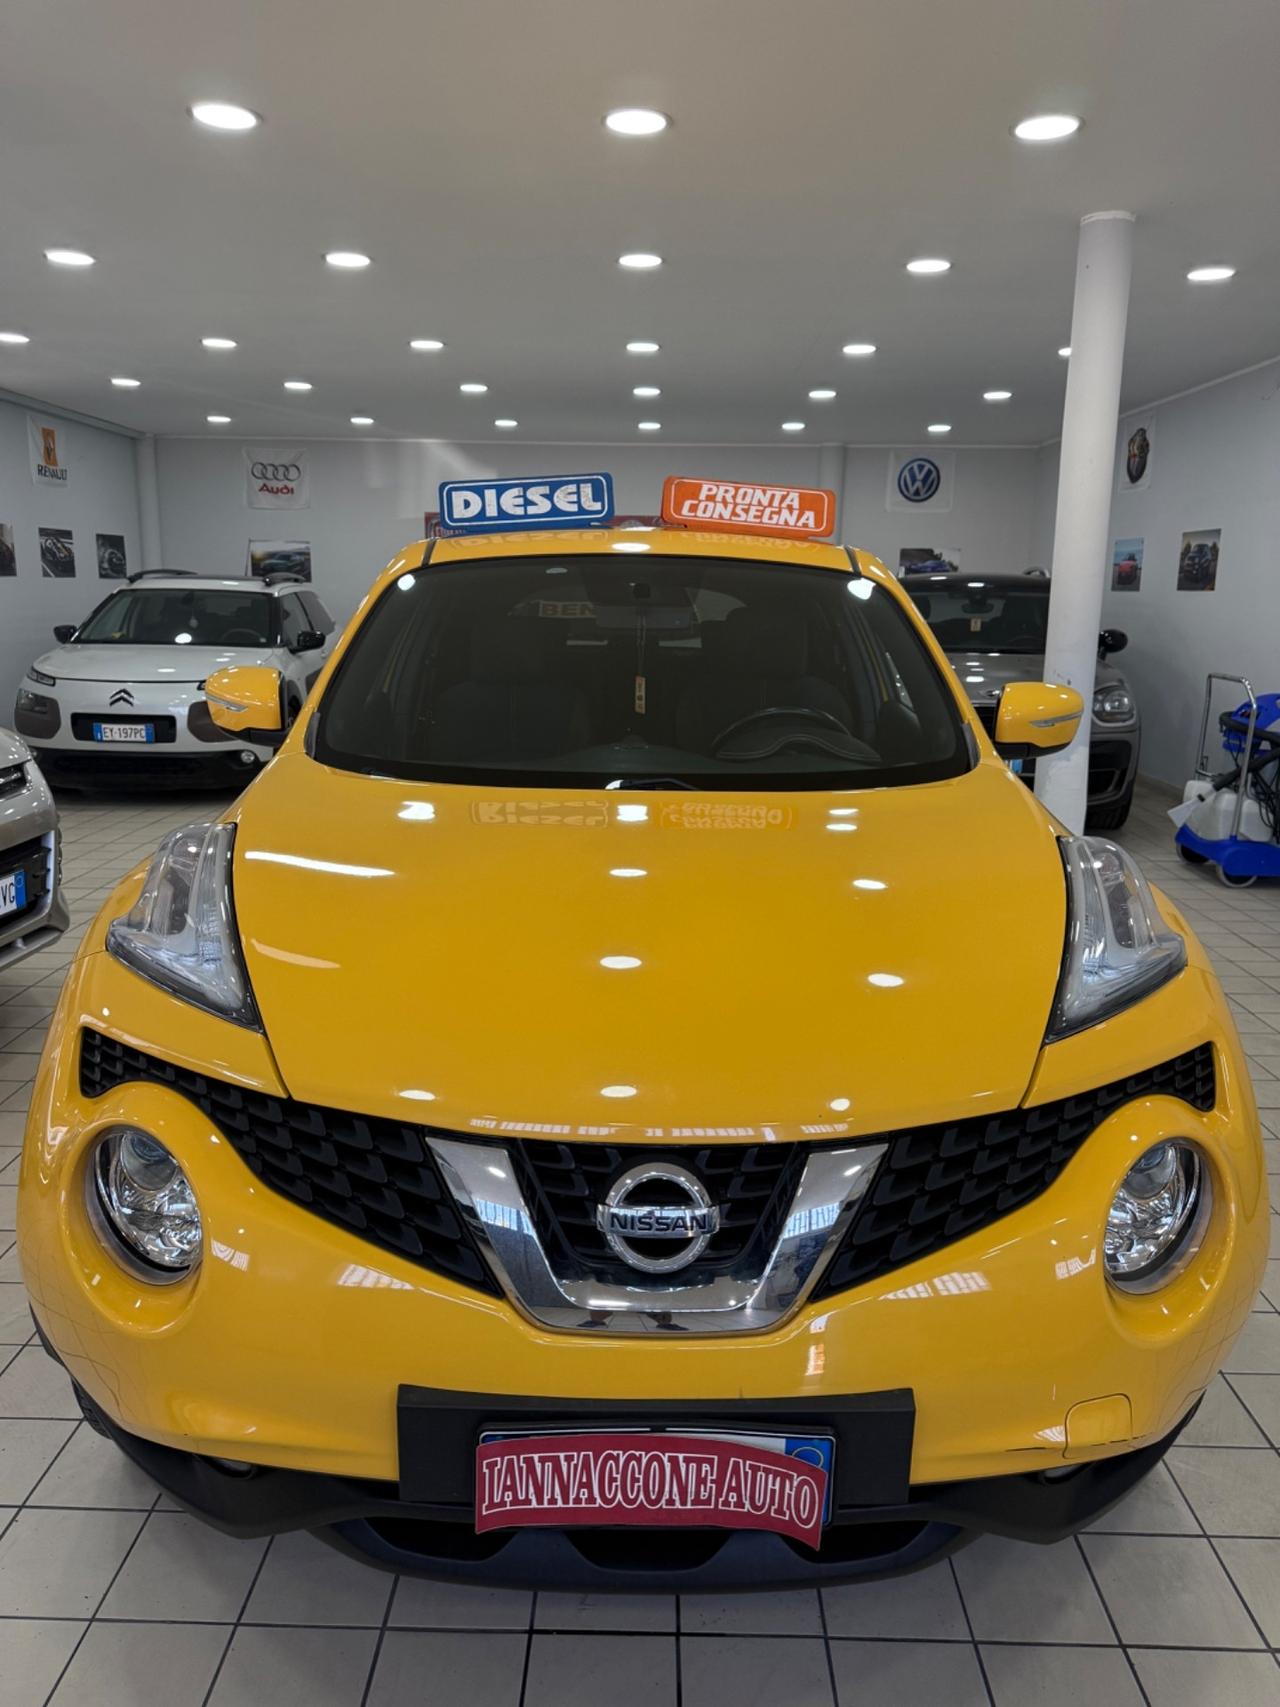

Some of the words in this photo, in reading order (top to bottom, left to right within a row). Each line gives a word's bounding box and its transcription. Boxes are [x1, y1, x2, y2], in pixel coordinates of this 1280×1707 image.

[259, 483, 294, 495] Audi
[452, 483, 602, 519] DIESEL
[699, 484, 800, 509] PRONTA
[681, 500, 815, 528] CONSEGNA
[0, 882, 16, 908] VG
[610, 1213, 708, 1232] NISSAN
[482, 1450, 718, 1515] IANNACCONE
[719, 1458, 819, 1529] AUTO
